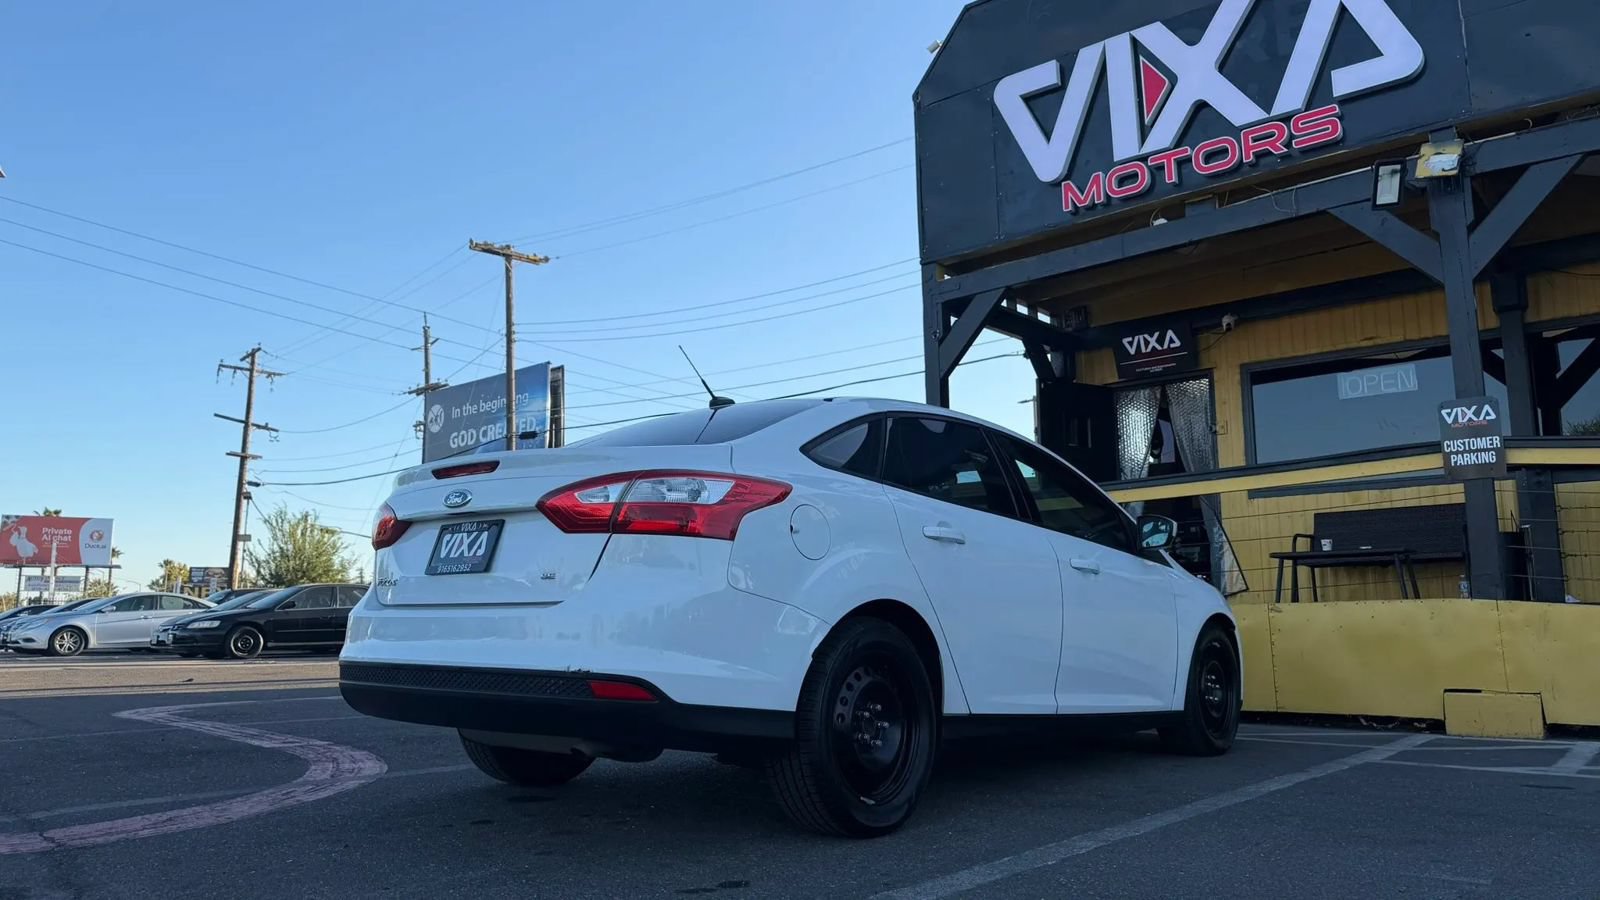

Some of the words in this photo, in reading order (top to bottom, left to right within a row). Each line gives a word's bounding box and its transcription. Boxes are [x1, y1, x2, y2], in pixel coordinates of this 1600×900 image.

[993, 0, 1425, 184] VIXA
[1061, 104, 1343, 213] MOTORS
[1121, 329, 1182, 356] VIXA
[1345, 368, 1414, 395] OPEN
[451, 406, 461, 419] In
[463, 403, 478, 416] the
[479, 392, 529, 413] beginng
[1440, 404, 1497, 424] VIXA
[449, 428, 477, 448] GOD
[1443, 435, 1501, 453] CUSTOMER
[1450, 450, 1497, 467] PARKING
[461, 522, 477, 531] VIXA
[440, 531, 489, 559] VIXA
